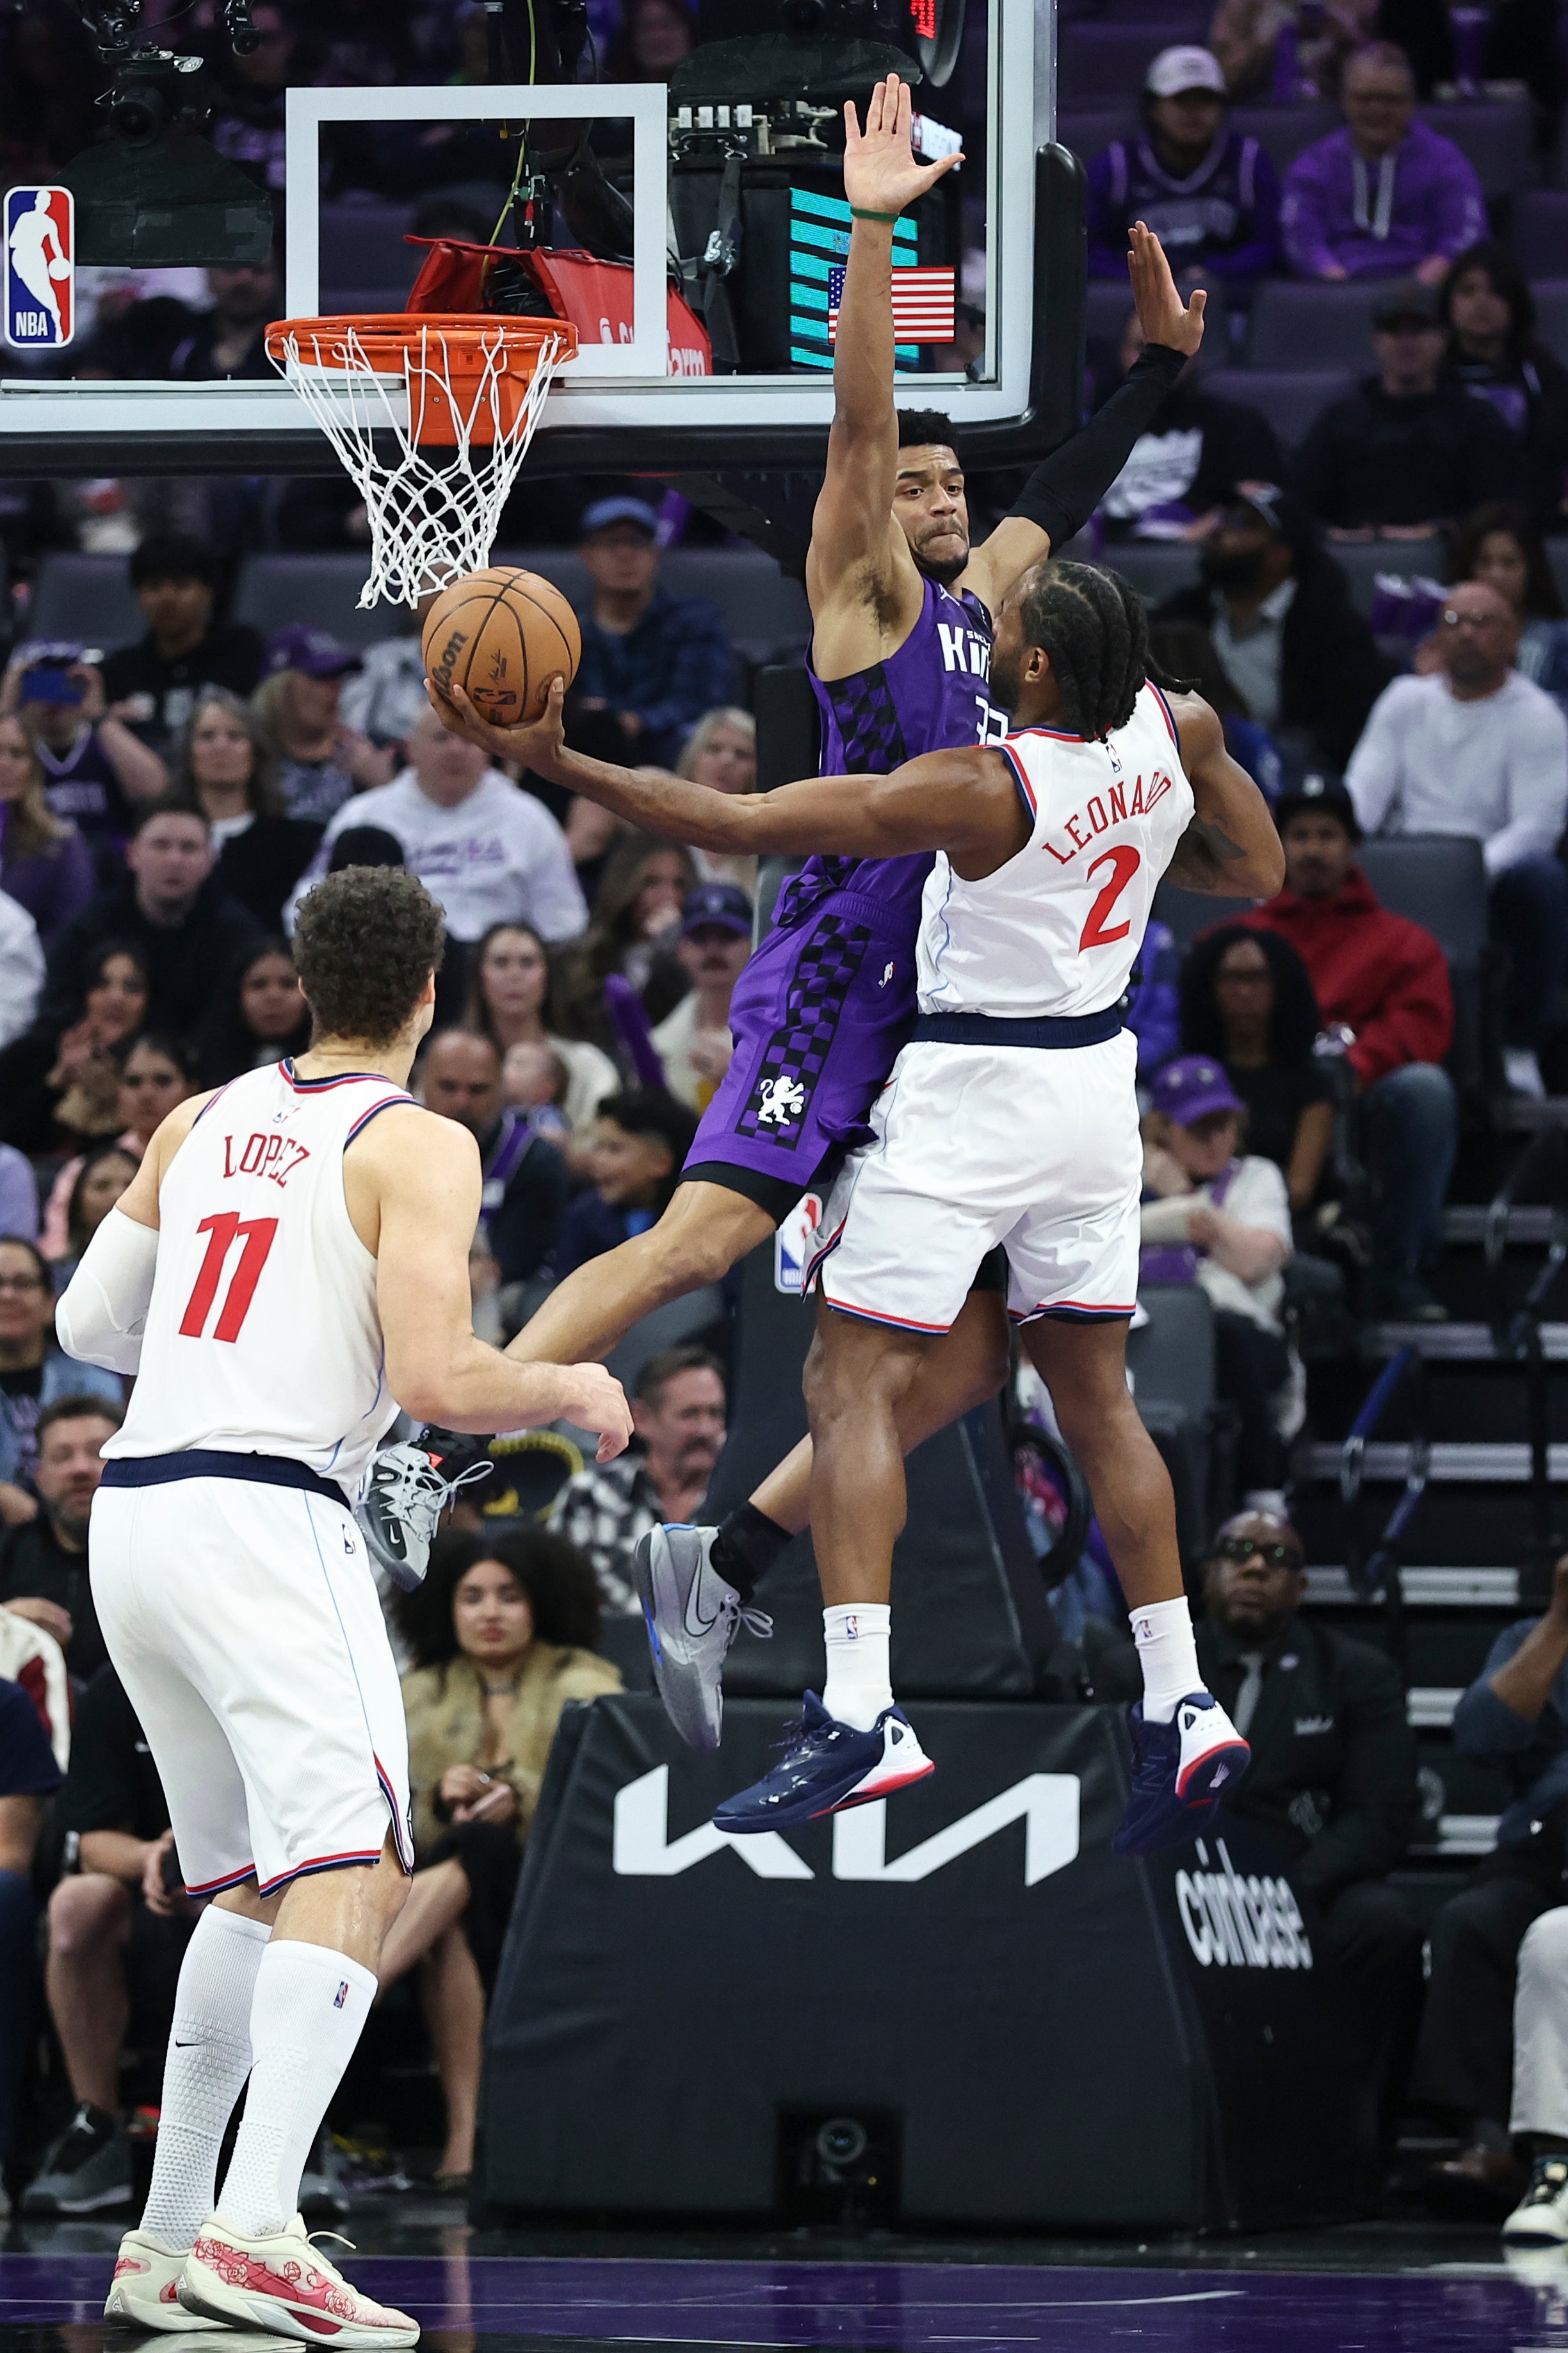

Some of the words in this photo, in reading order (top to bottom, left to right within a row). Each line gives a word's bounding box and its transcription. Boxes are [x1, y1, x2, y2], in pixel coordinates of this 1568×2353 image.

[15, 311, 49, 337] NBA
[667, 329, 706, 377] arm
[1078, 845, 1141, 959] 2
[223, 1133, 311, 1189] LOPEZ
[178, 1211, 279, 1344] 11
[613, 1763, 1081, 1887] KIA
[1176, 1837, 1313, 1970] coinbase
